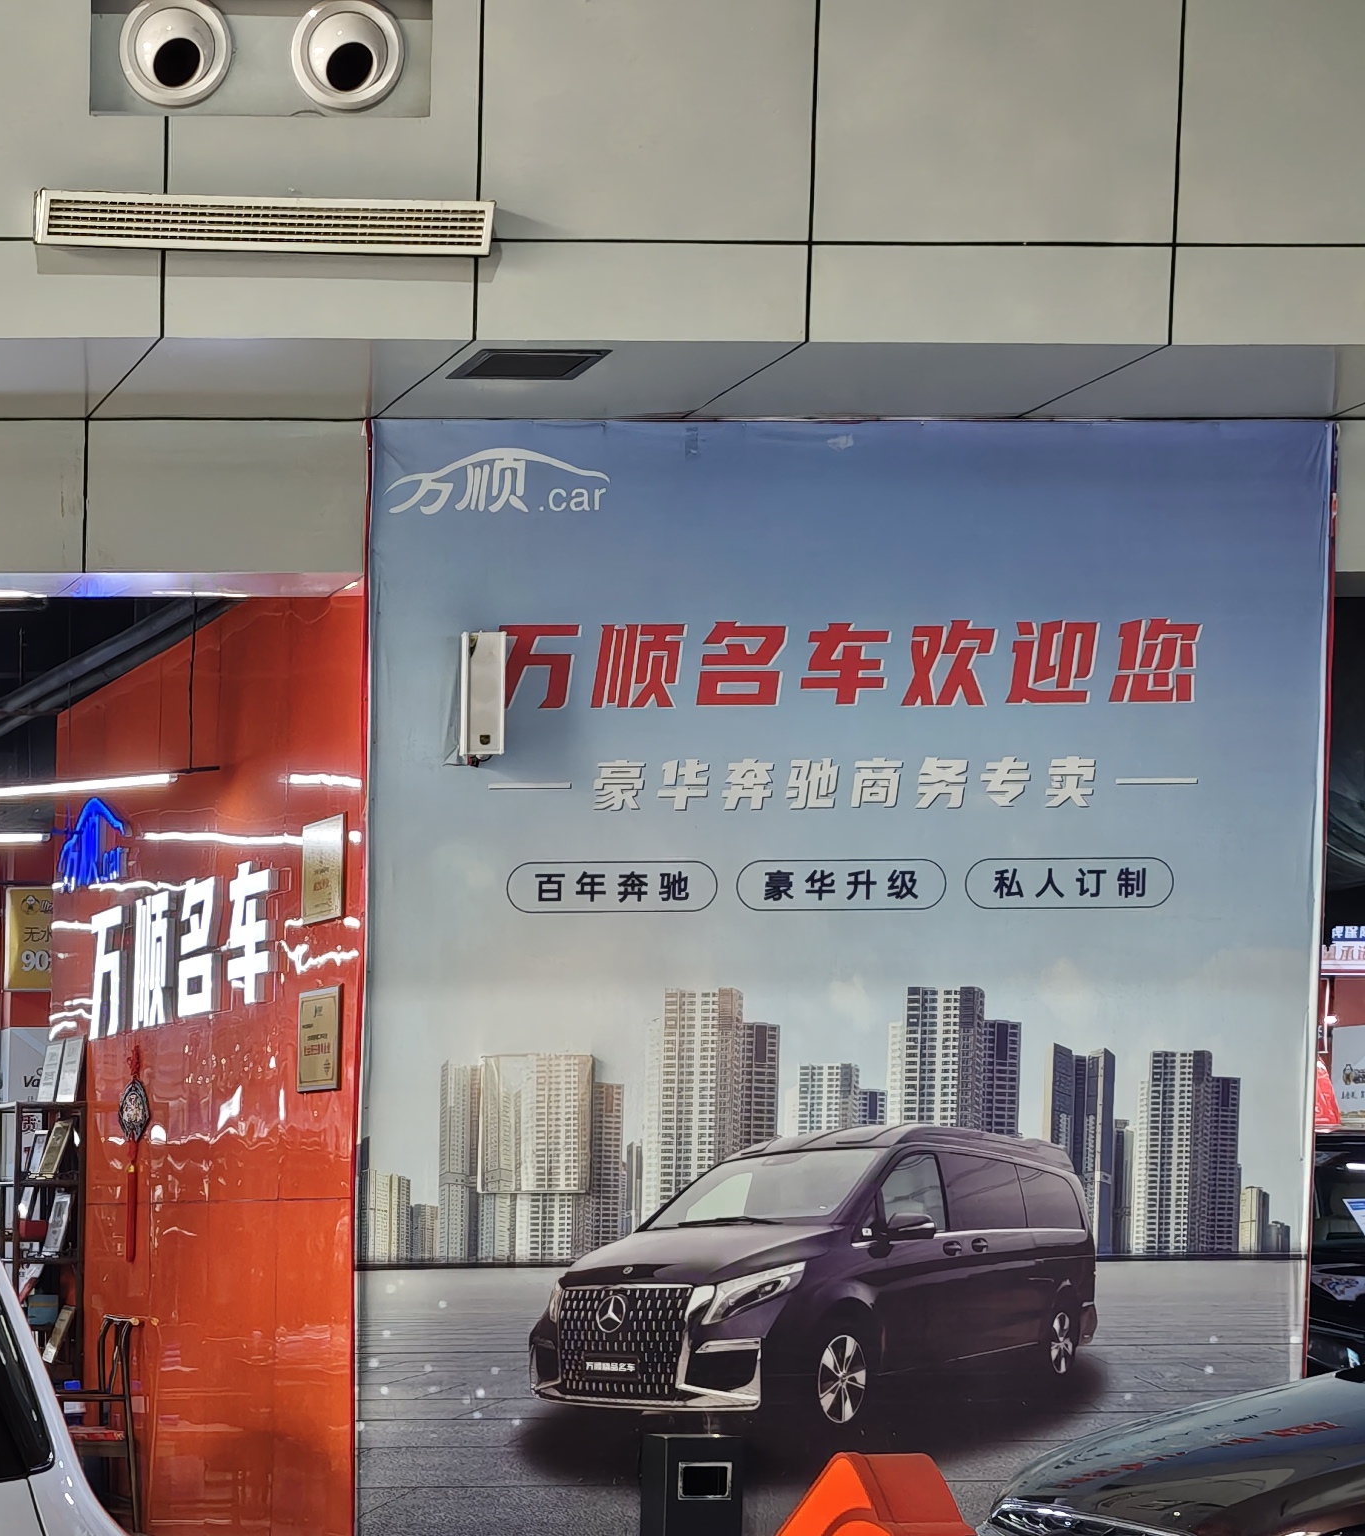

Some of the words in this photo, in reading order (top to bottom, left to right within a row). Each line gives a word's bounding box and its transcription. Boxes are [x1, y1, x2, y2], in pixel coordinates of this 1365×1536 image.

[499, 617, 1204, 710] 万顺名车欢迎您
[591, 757, 1099, 812] 豪华奔驰商务专卖
[534, 870, 692, 904] 百年奔驰
[762, 868, 921, 903] 豪华升级
[993, 865, 1150, 900] 私人订制
[88, 860, 273, 1042] 万顺名车
